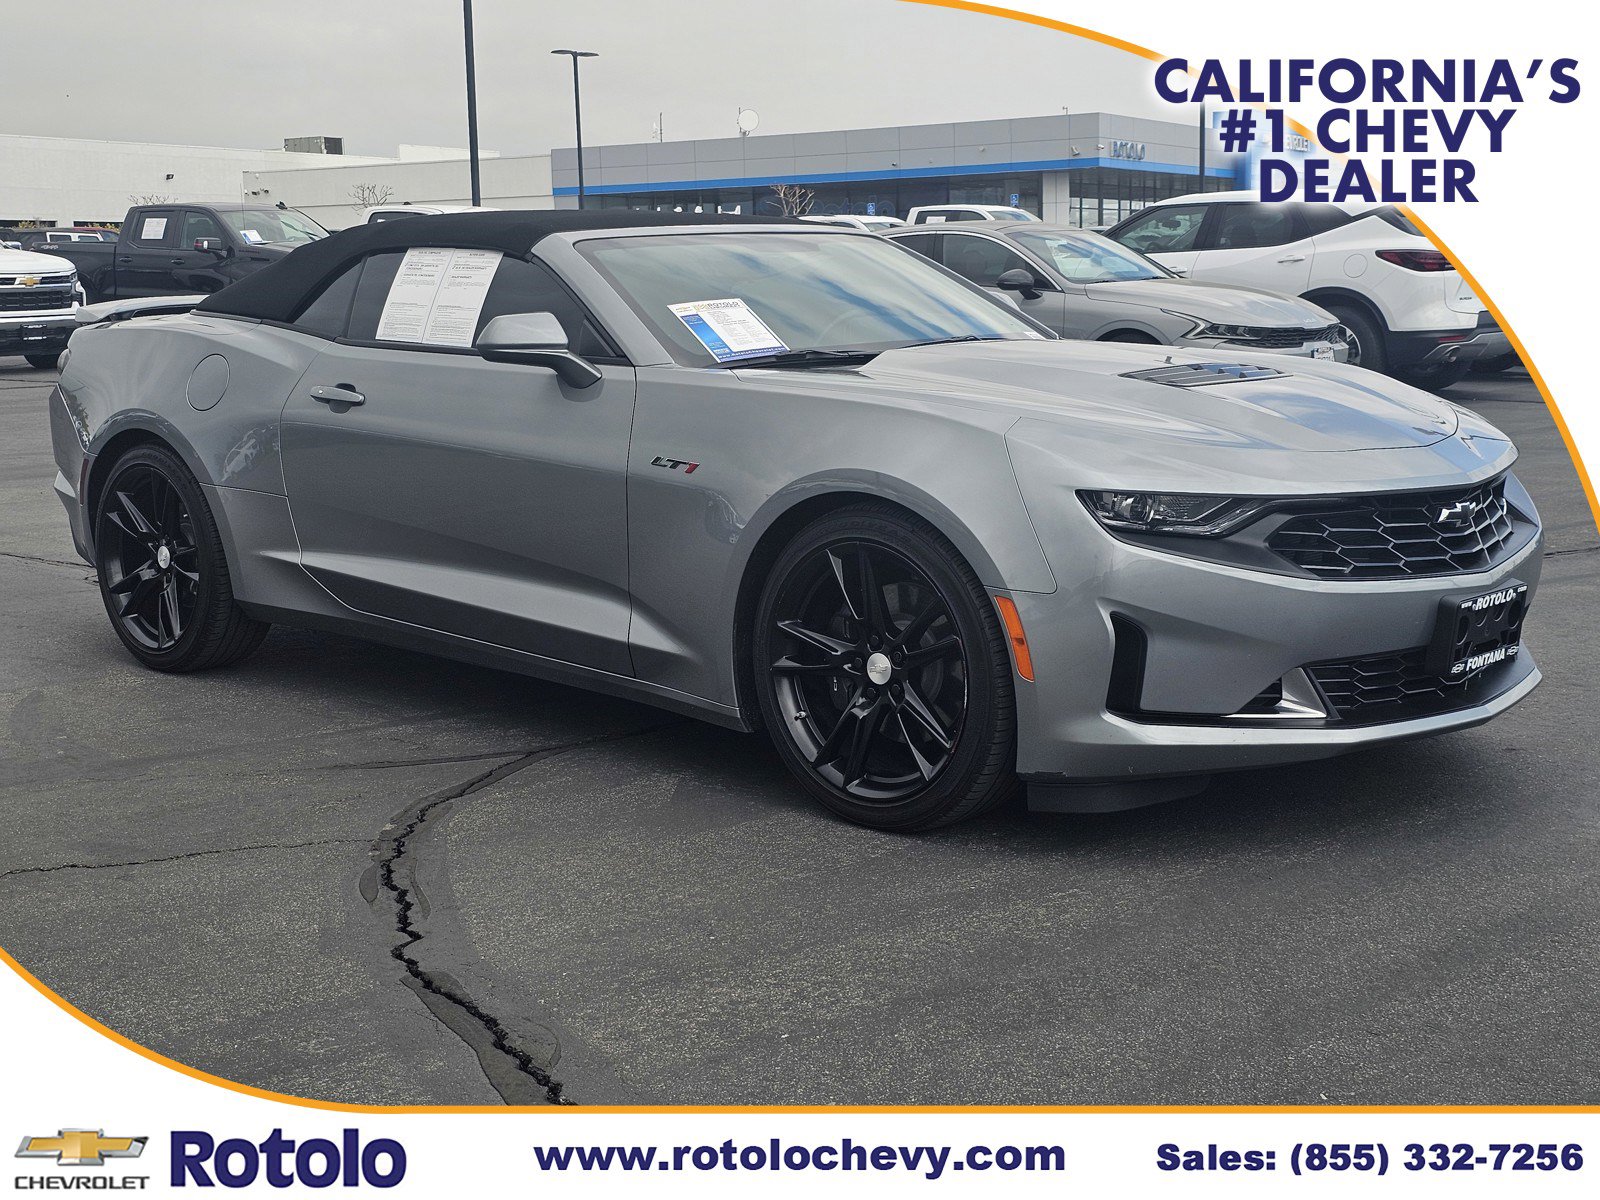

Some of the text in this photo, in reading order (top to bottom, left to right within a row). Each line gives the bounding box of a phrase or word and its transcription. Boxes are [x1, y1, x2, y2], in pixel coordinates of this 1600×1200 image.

[650, 456, 700, 474] LT1
[1474, 588, 1514, 611] ROTOLO
[1466, 648, 1506, 672] FONTANA
